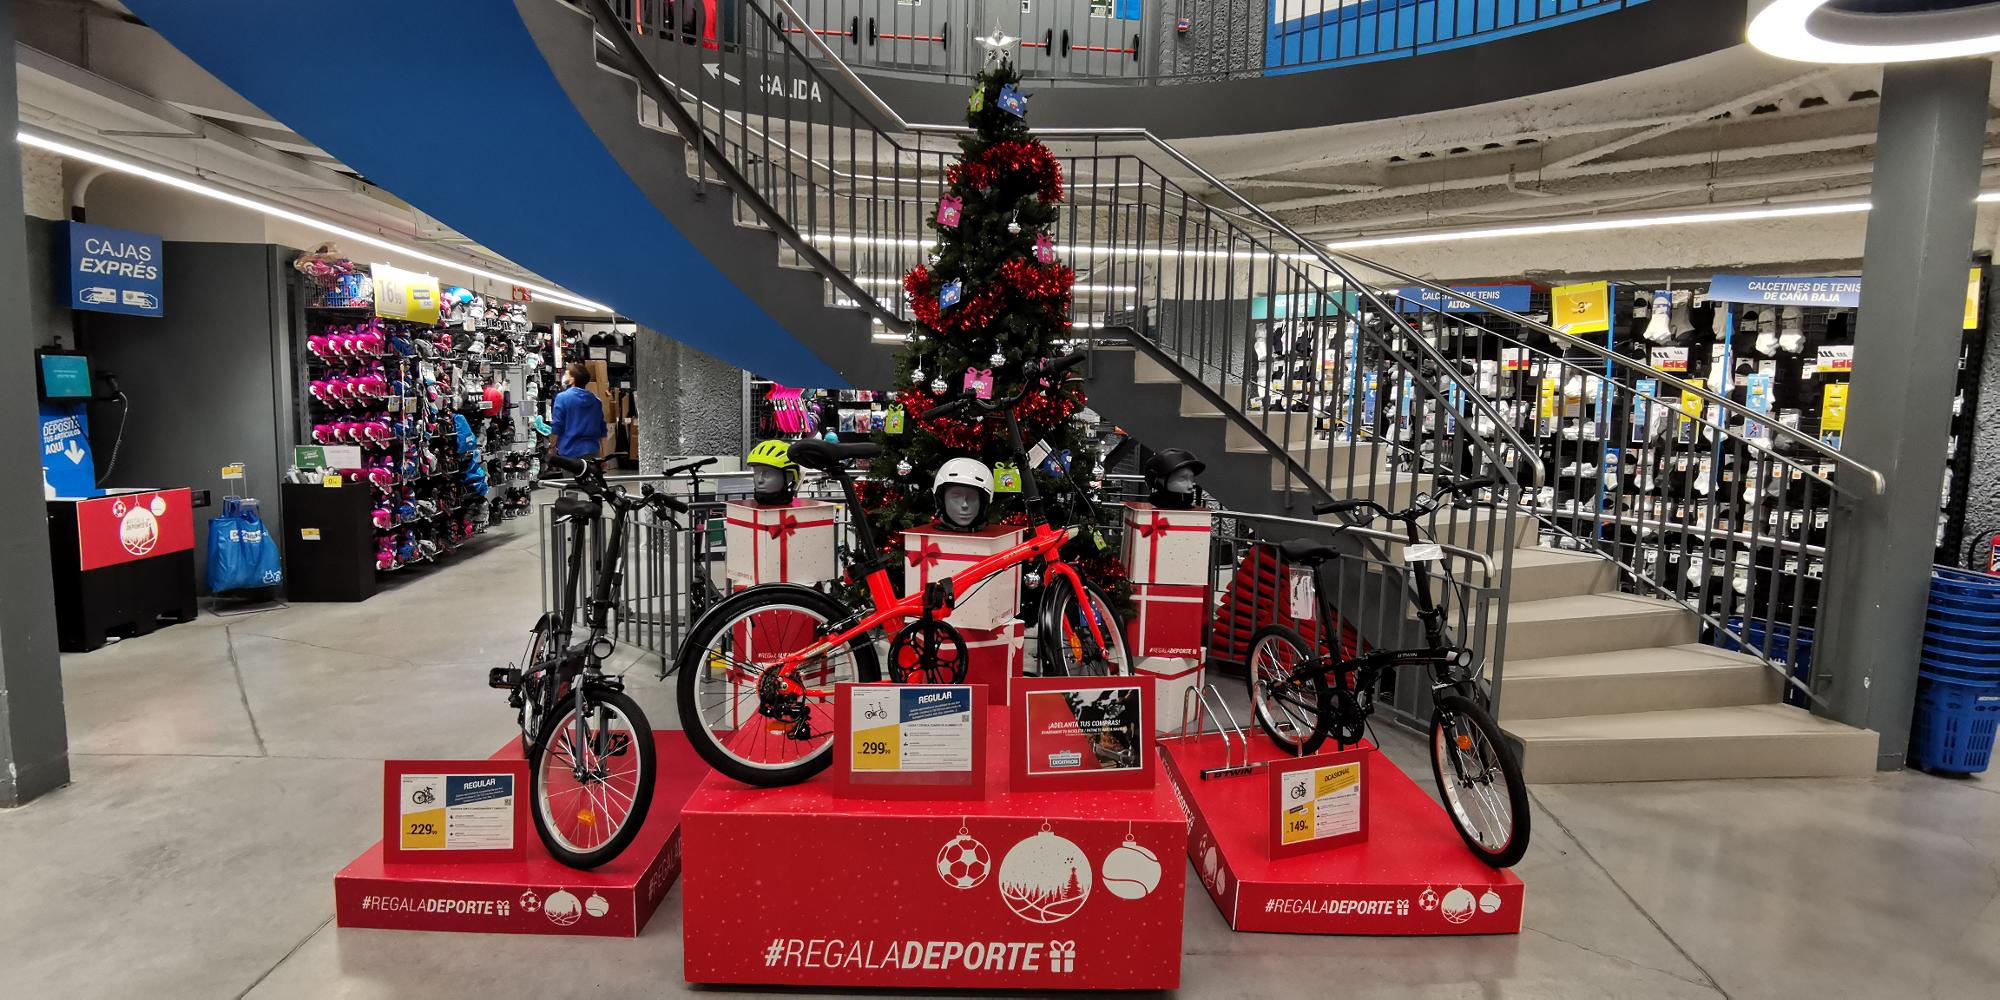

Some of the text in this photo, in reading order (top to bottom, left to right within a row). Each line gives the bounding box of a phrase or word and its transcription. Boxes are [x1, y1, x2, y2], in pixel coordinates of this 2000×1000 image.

[85, 238, 151, 262] CAJAS
[80, 257, 158, 280] EXPRÉS
[1748, 281, 1862, 293] CALCETINES DE TENIS
[1478, 290, 1500, 300] TENIS
[1763, 291, 1840, 302] DE CAÑA BAJA
[1447, 301, 1471, 309] ALTOS
[45, 438, 65, 455] AQUÍ
[918, 691, 952, 704] REGULAR
[1092, 719, 1121, 727] COMPRAS!
[1324, 767, 1350, 782] OCASIONAL
[463, 778, 496, 790] REGULAR
[362, 896, 494, 915] #REGALADEPORTE
[1264, 898, 1395, 915] #REGALADEPORTE
[764, 938, 1044, 972] #REGALADEPORTE
